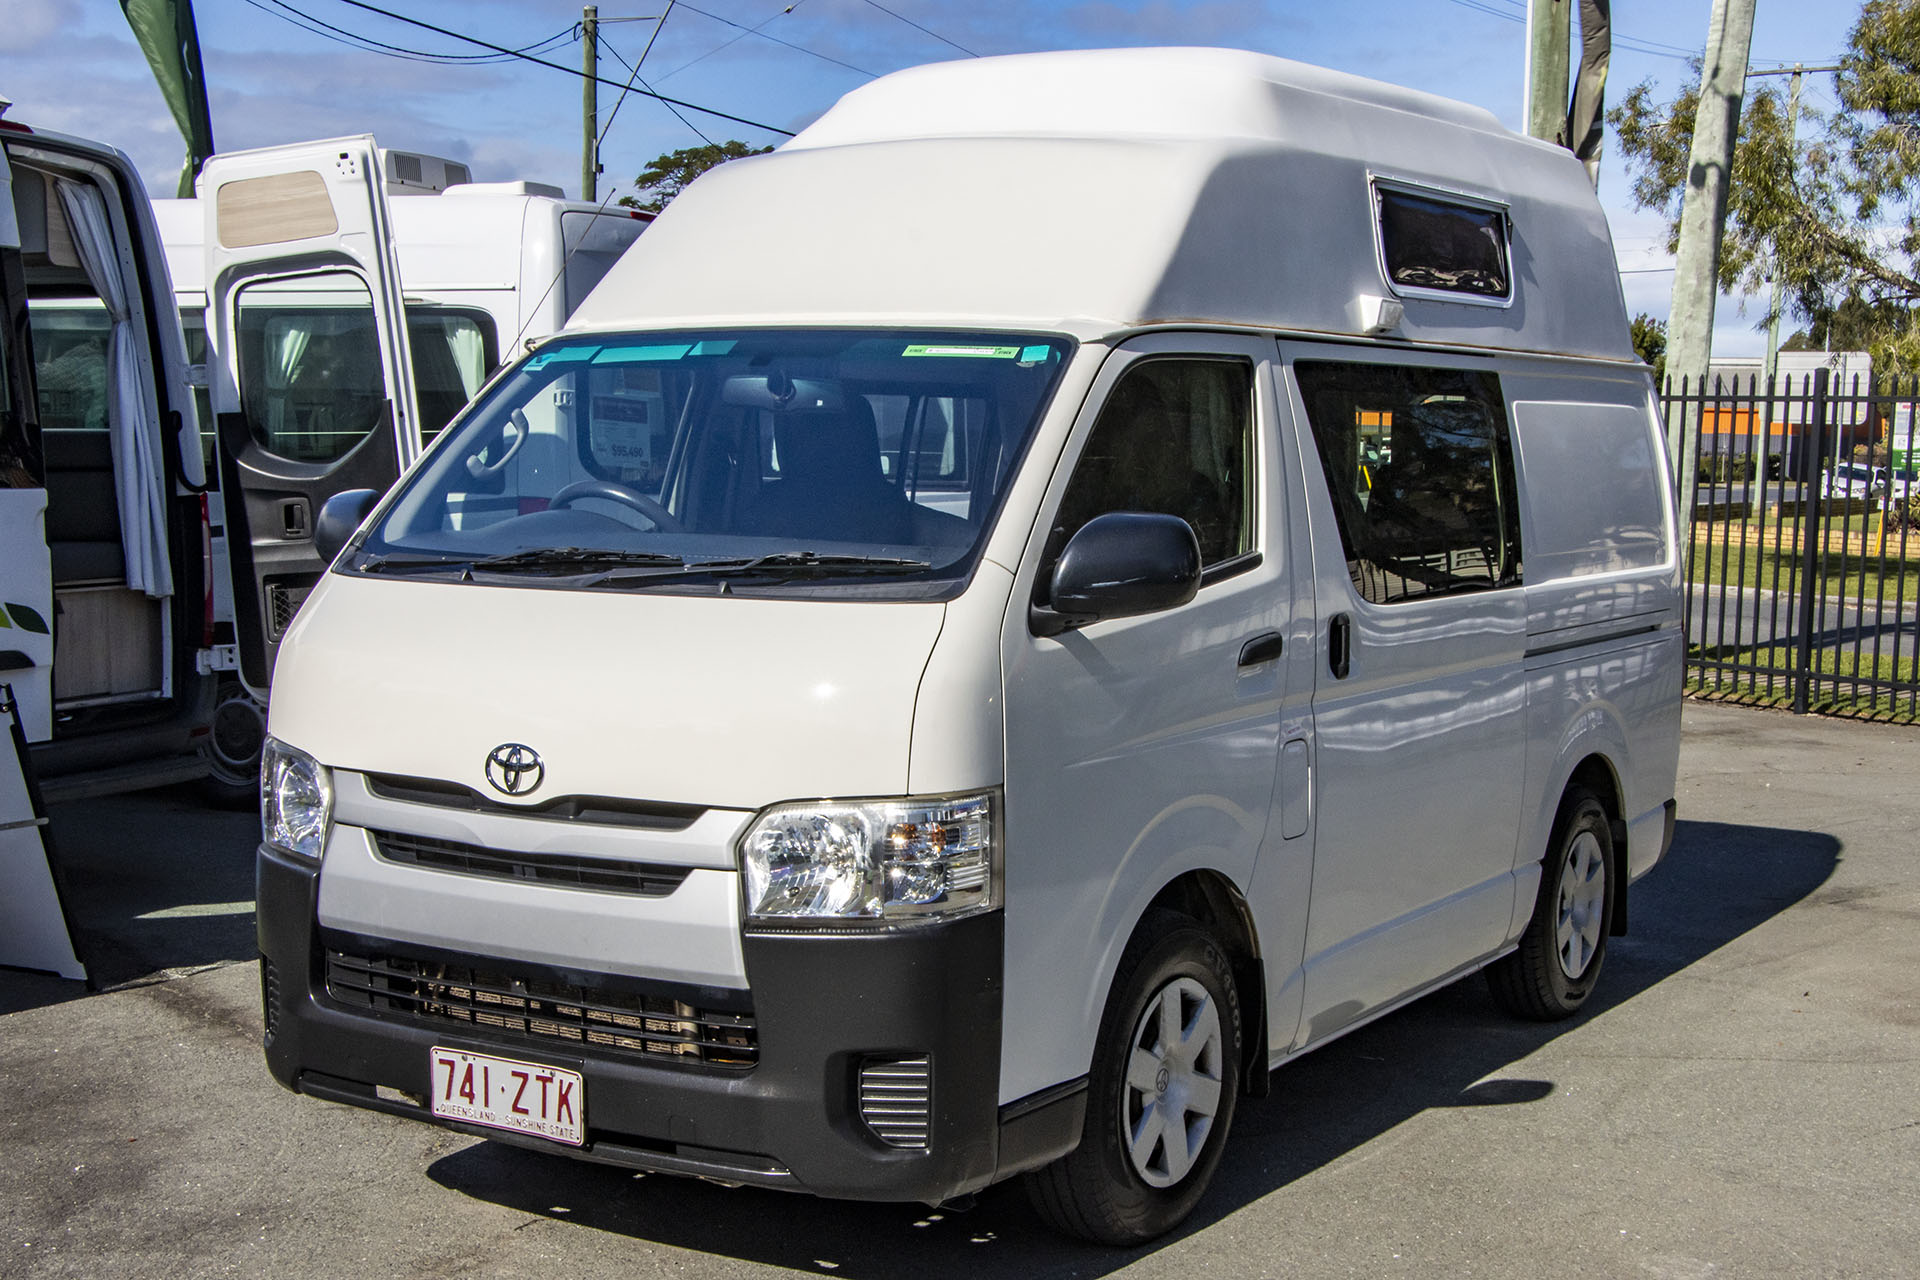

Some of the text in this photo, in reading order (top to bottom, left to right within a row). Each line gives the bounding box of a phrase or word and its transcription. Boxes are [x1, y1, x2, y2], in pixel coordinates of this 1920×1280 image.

[438, 1058, 574, 1125] 741 ZTK
[440, 1103, 575, 1139] QUEENSLAND SUNSHINE STATE
